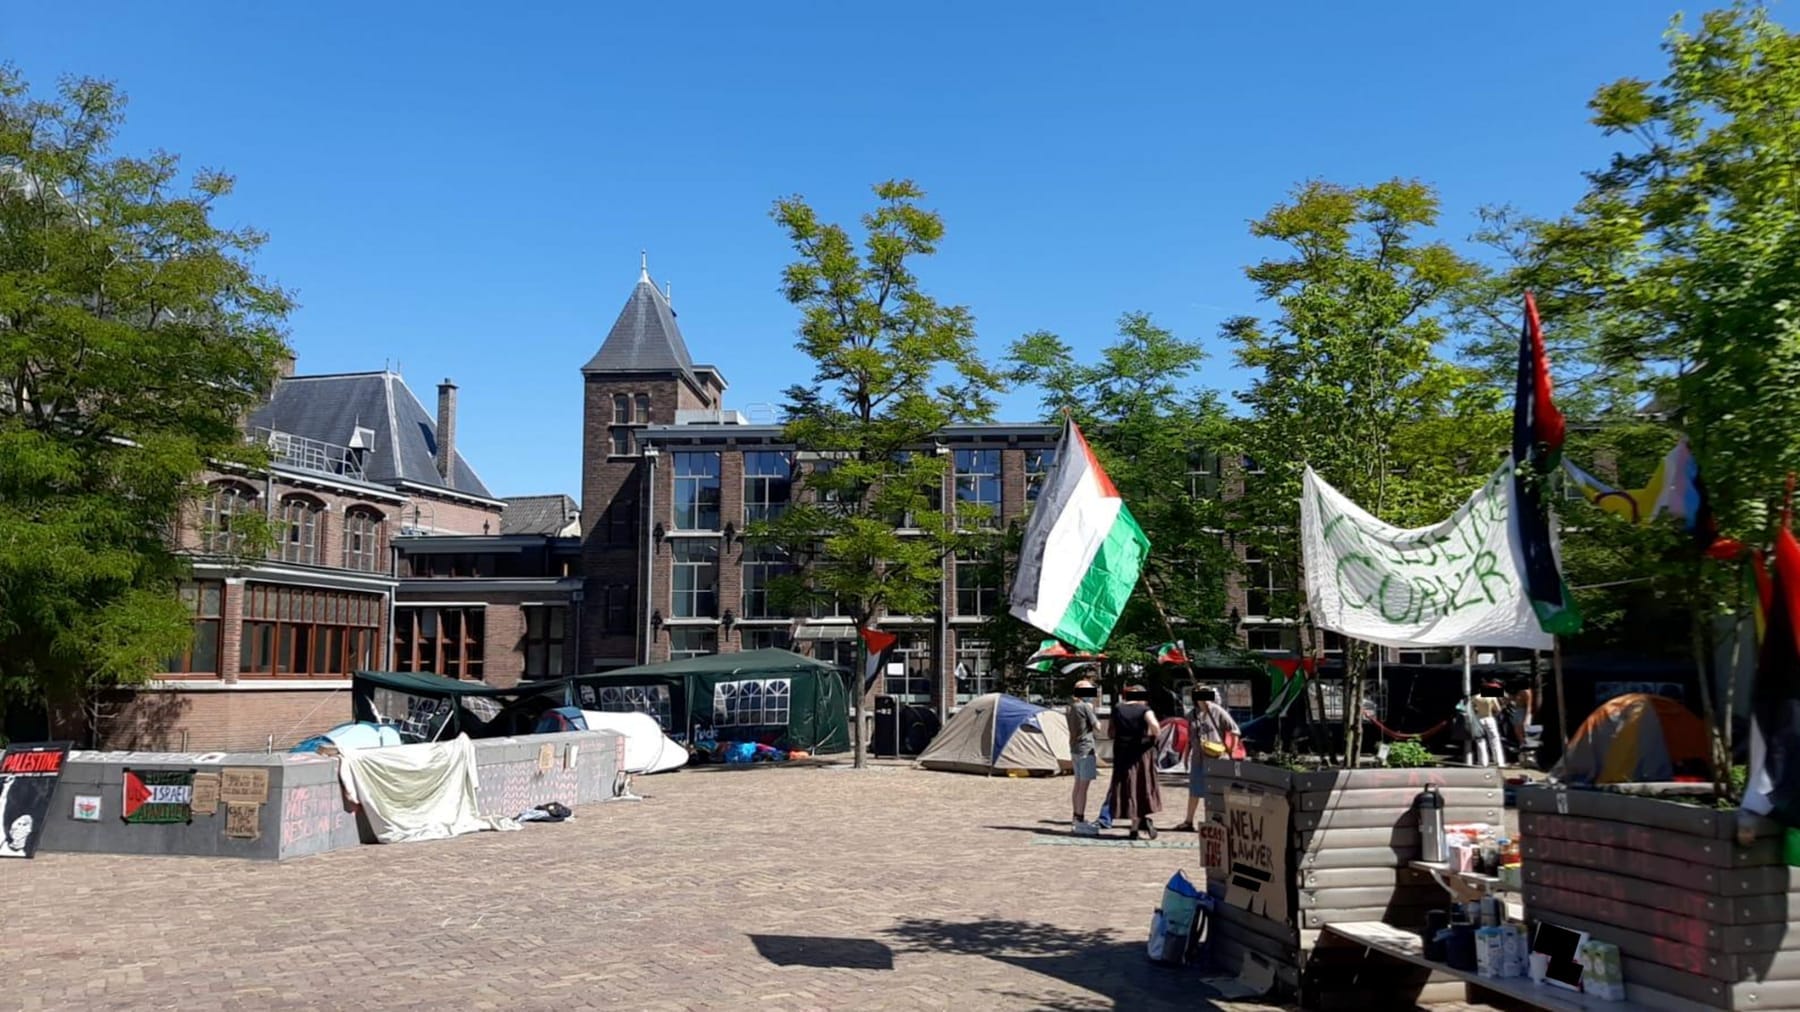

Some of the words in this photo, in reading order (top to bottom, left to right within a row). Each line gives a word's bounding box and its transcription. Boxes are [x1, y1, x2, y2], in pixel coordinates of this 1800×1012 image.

[2, 751, 63, 771] PALESTINE
[153, 786, 188, 803] ISRAEL
[1230, 809, 1264, 841] NEW
[1231, 838, 1274, 871] LAWYER
